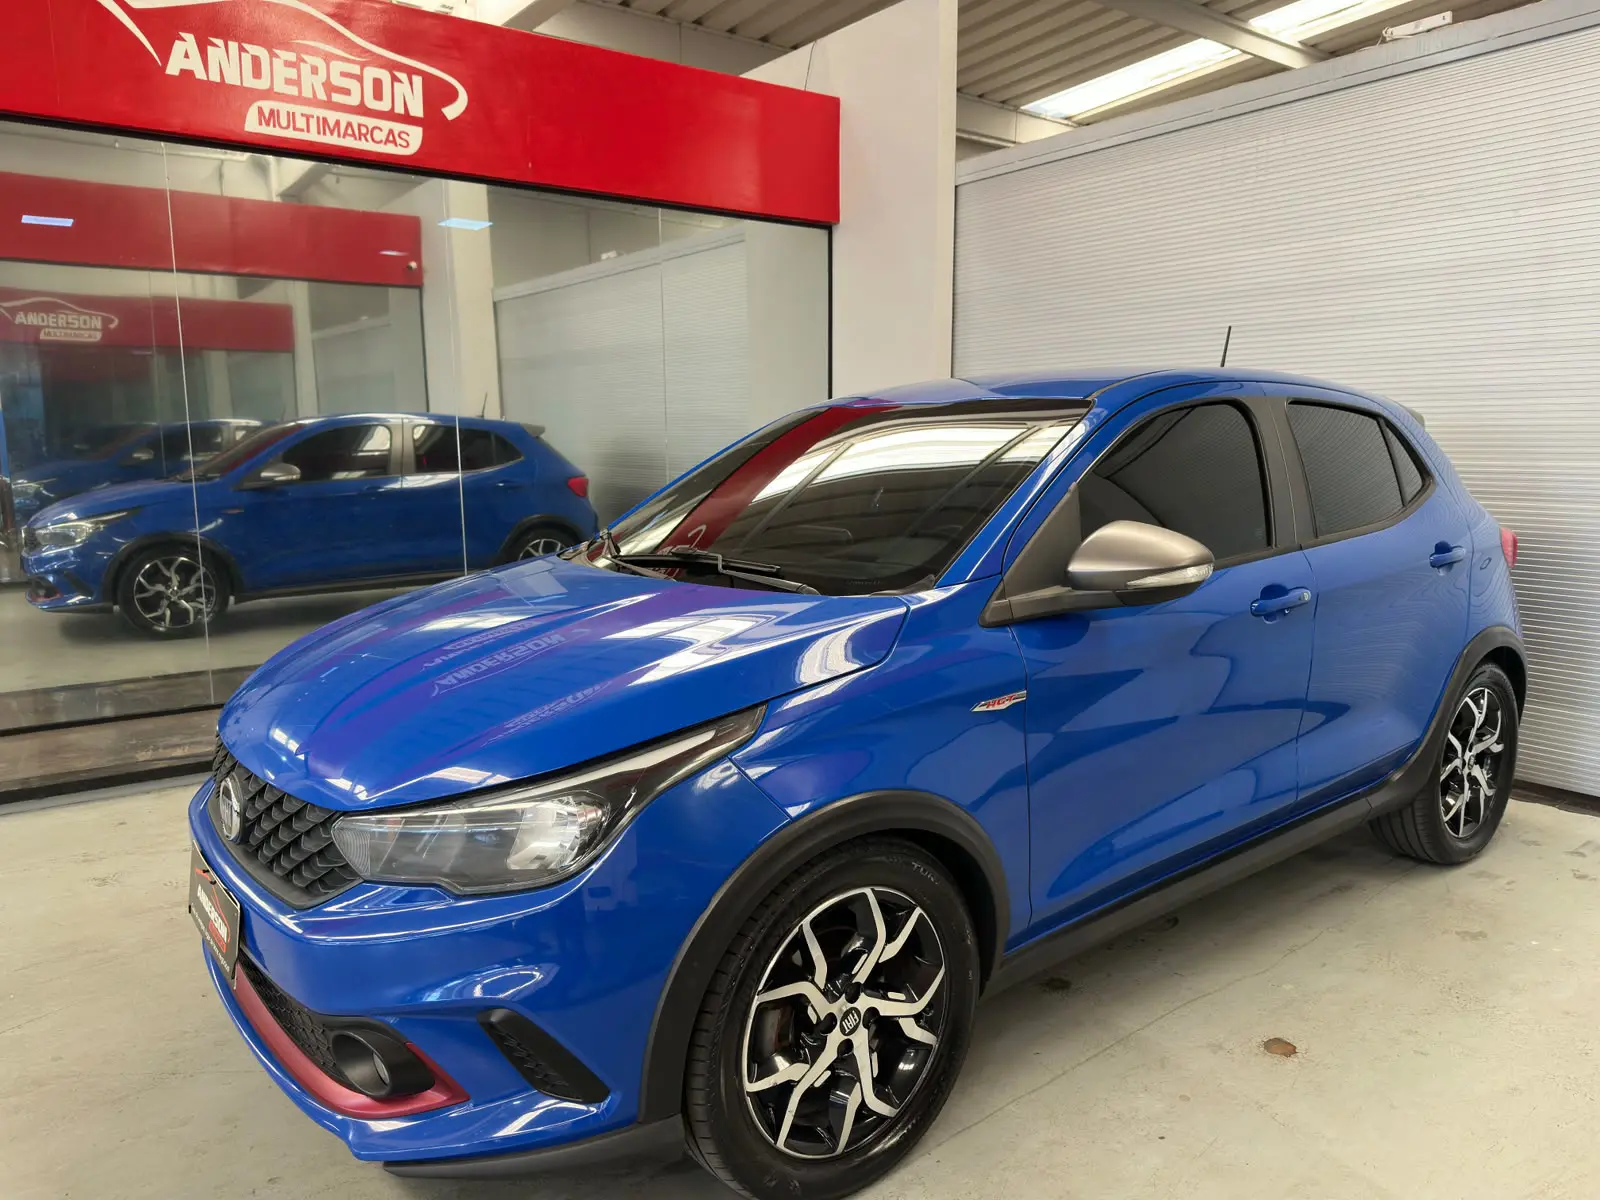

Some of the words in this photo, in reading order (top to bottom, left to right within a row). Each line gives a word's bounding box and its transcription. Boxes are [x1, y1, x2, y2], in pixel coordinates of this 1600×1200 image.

[165, 31, 424, 117] ANDERSON
[257, 106, 410, 149] MULTIMARCAS
[14, 311, 102, 329] ANDERSON
[841, 1009, 860, 1034] FIAT
